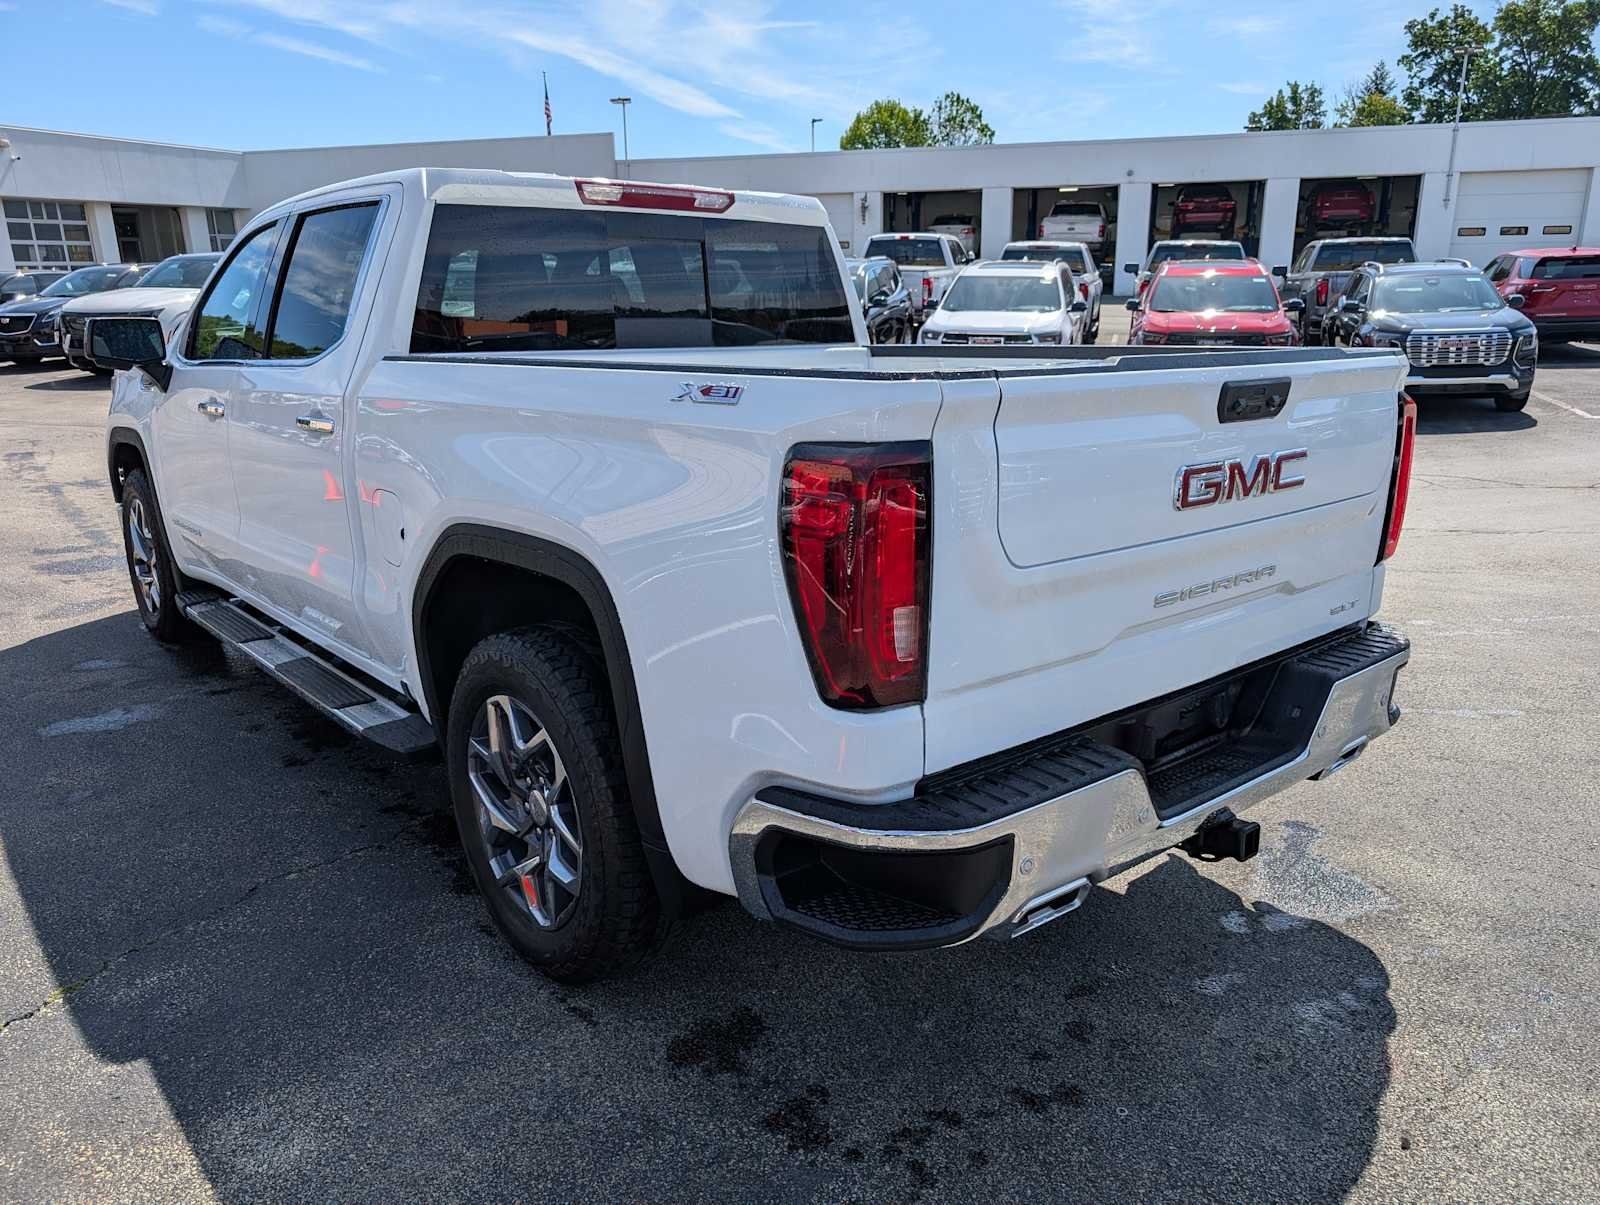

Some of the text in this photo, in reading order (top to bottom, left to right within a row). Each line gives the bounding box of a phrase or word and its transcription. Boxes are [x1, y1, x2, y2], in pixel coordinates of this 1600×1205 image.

[1173, 448, 1308, 511] GMC
[1153, 565, 1276, 608] SIERRA
[1329, 599, 1360, 616] SLT
